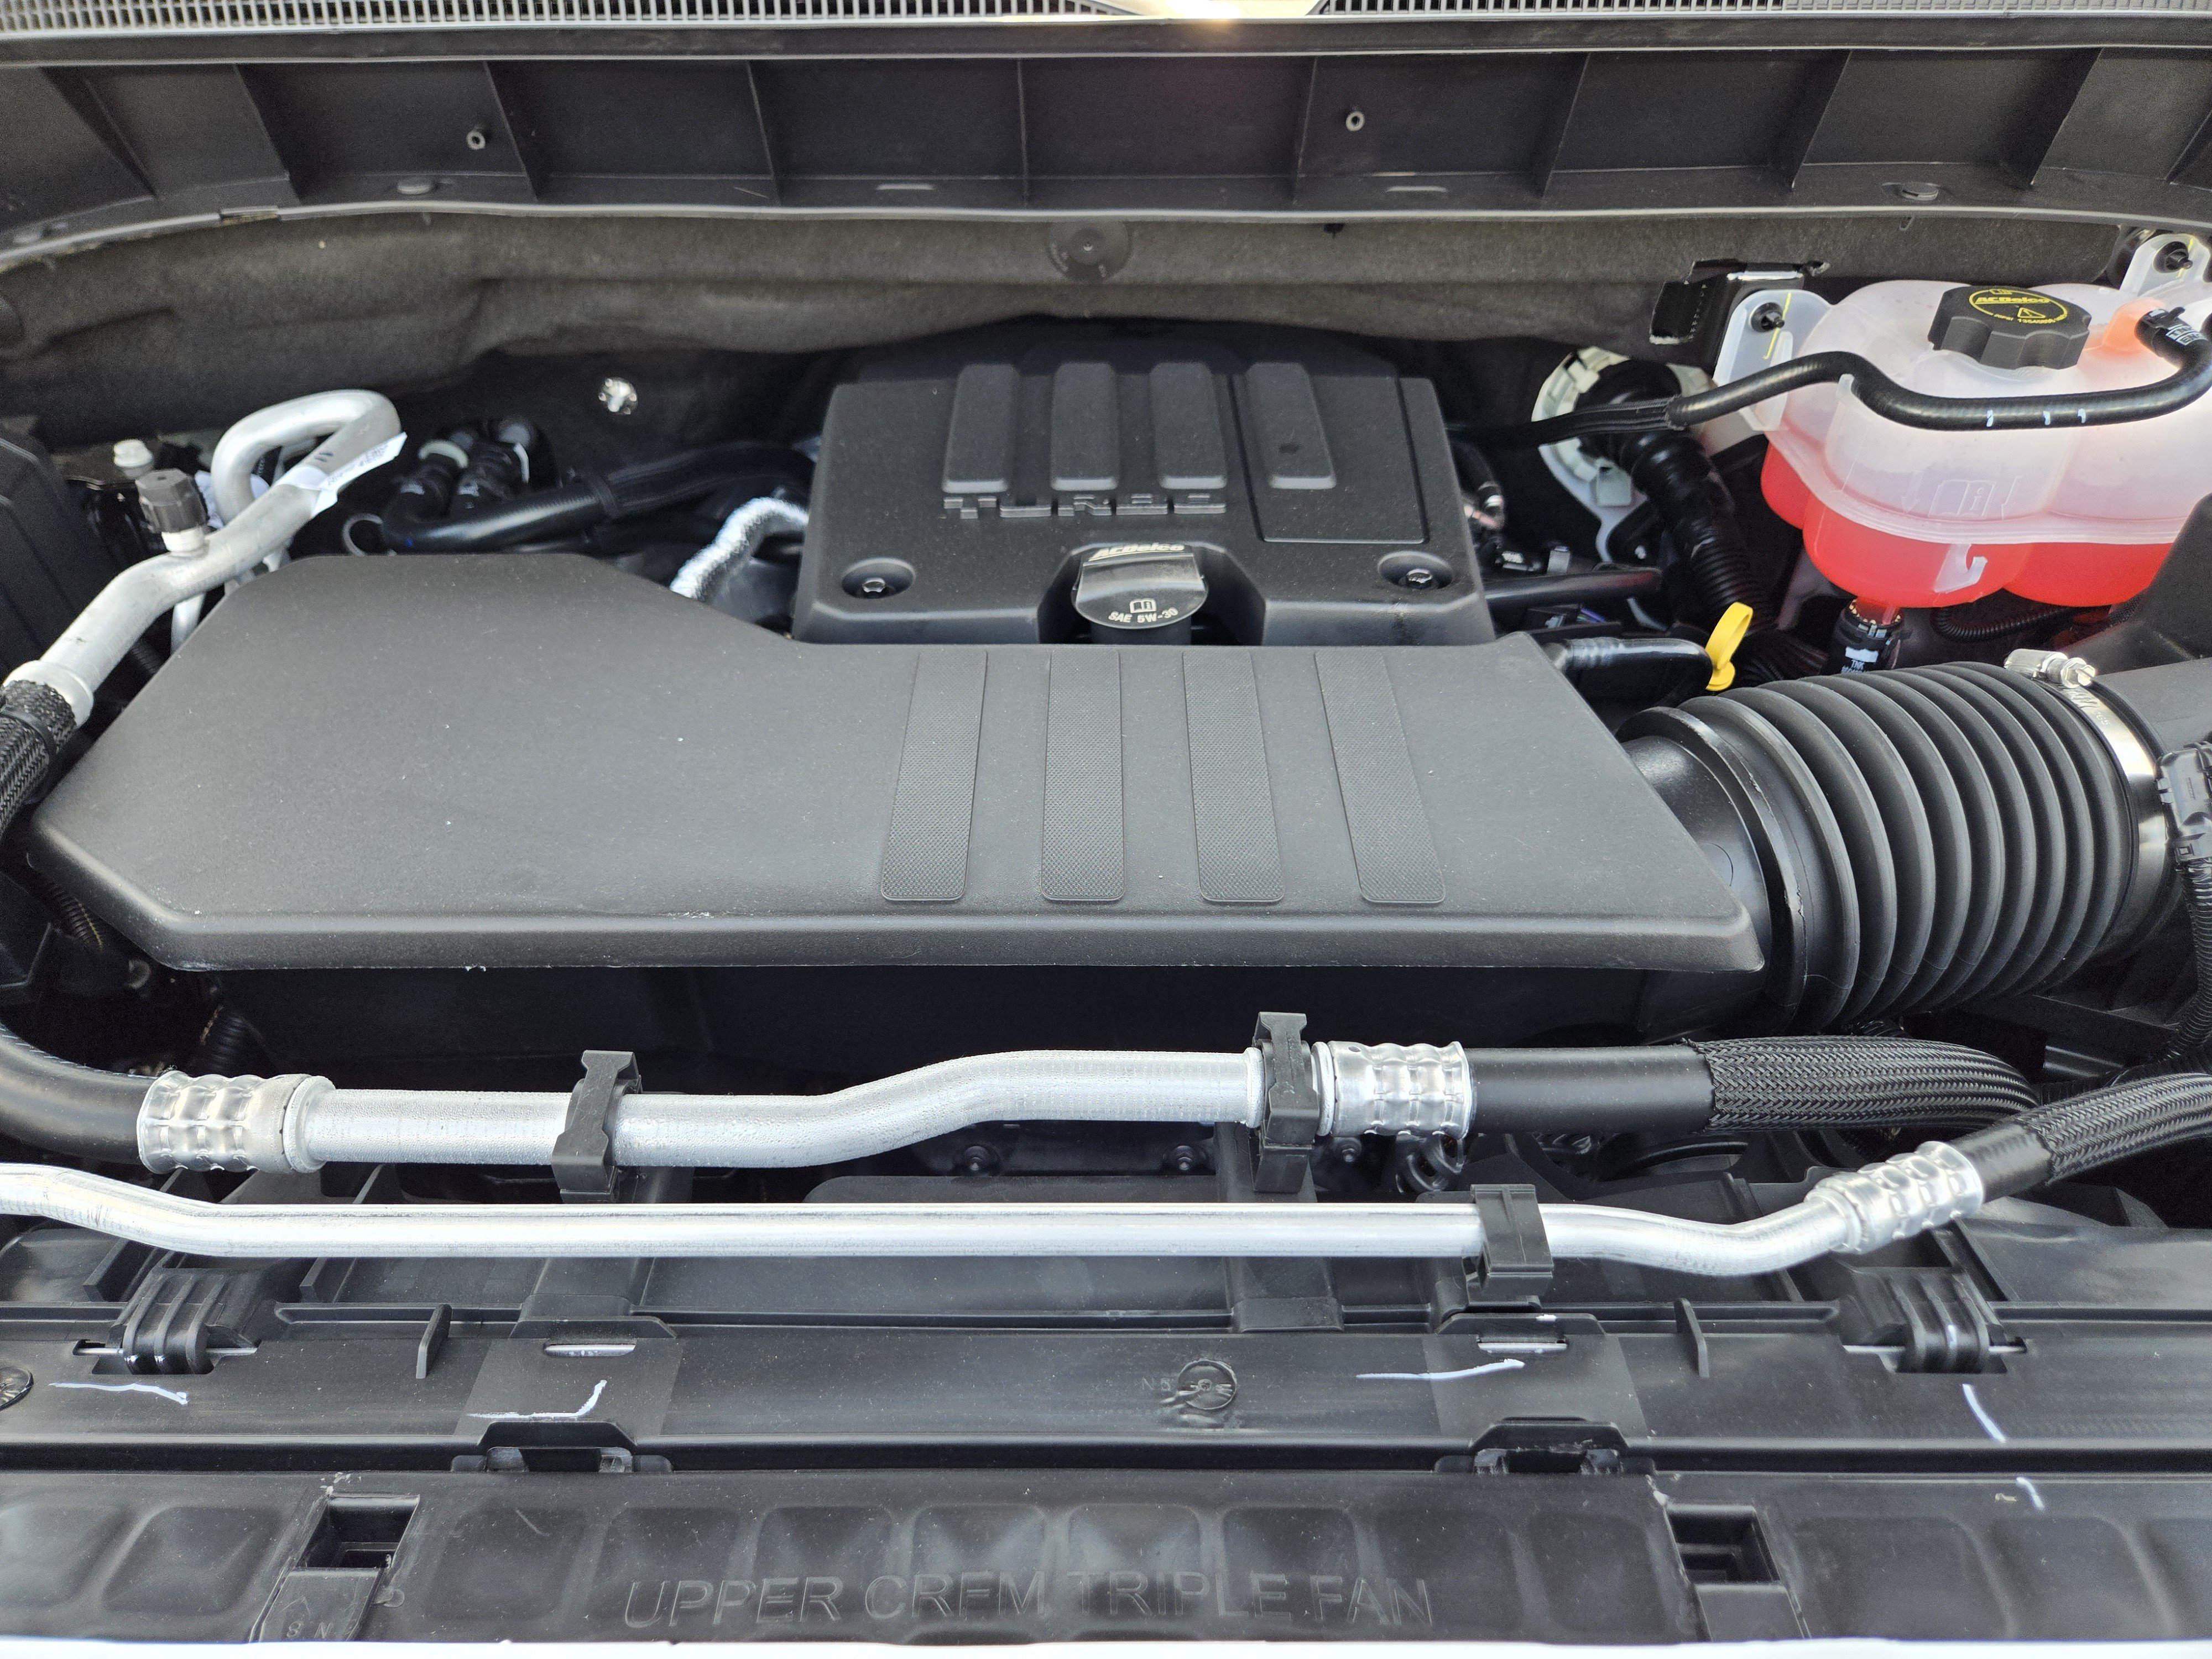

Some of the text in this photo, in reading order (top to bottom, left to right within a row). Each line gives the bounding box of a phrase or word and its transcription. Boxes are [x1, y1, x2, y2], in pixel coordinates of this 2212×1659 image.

[1088, 542, 1185, 562] ACDelco
[1108, 607, 1178, 623] SAE 5W-30
[625, 1575, 844, 1629] UPPER
[1066, 1571, 1291, 1619] TRIPLE
[1308, 1574, 1433, 1626] FAN
